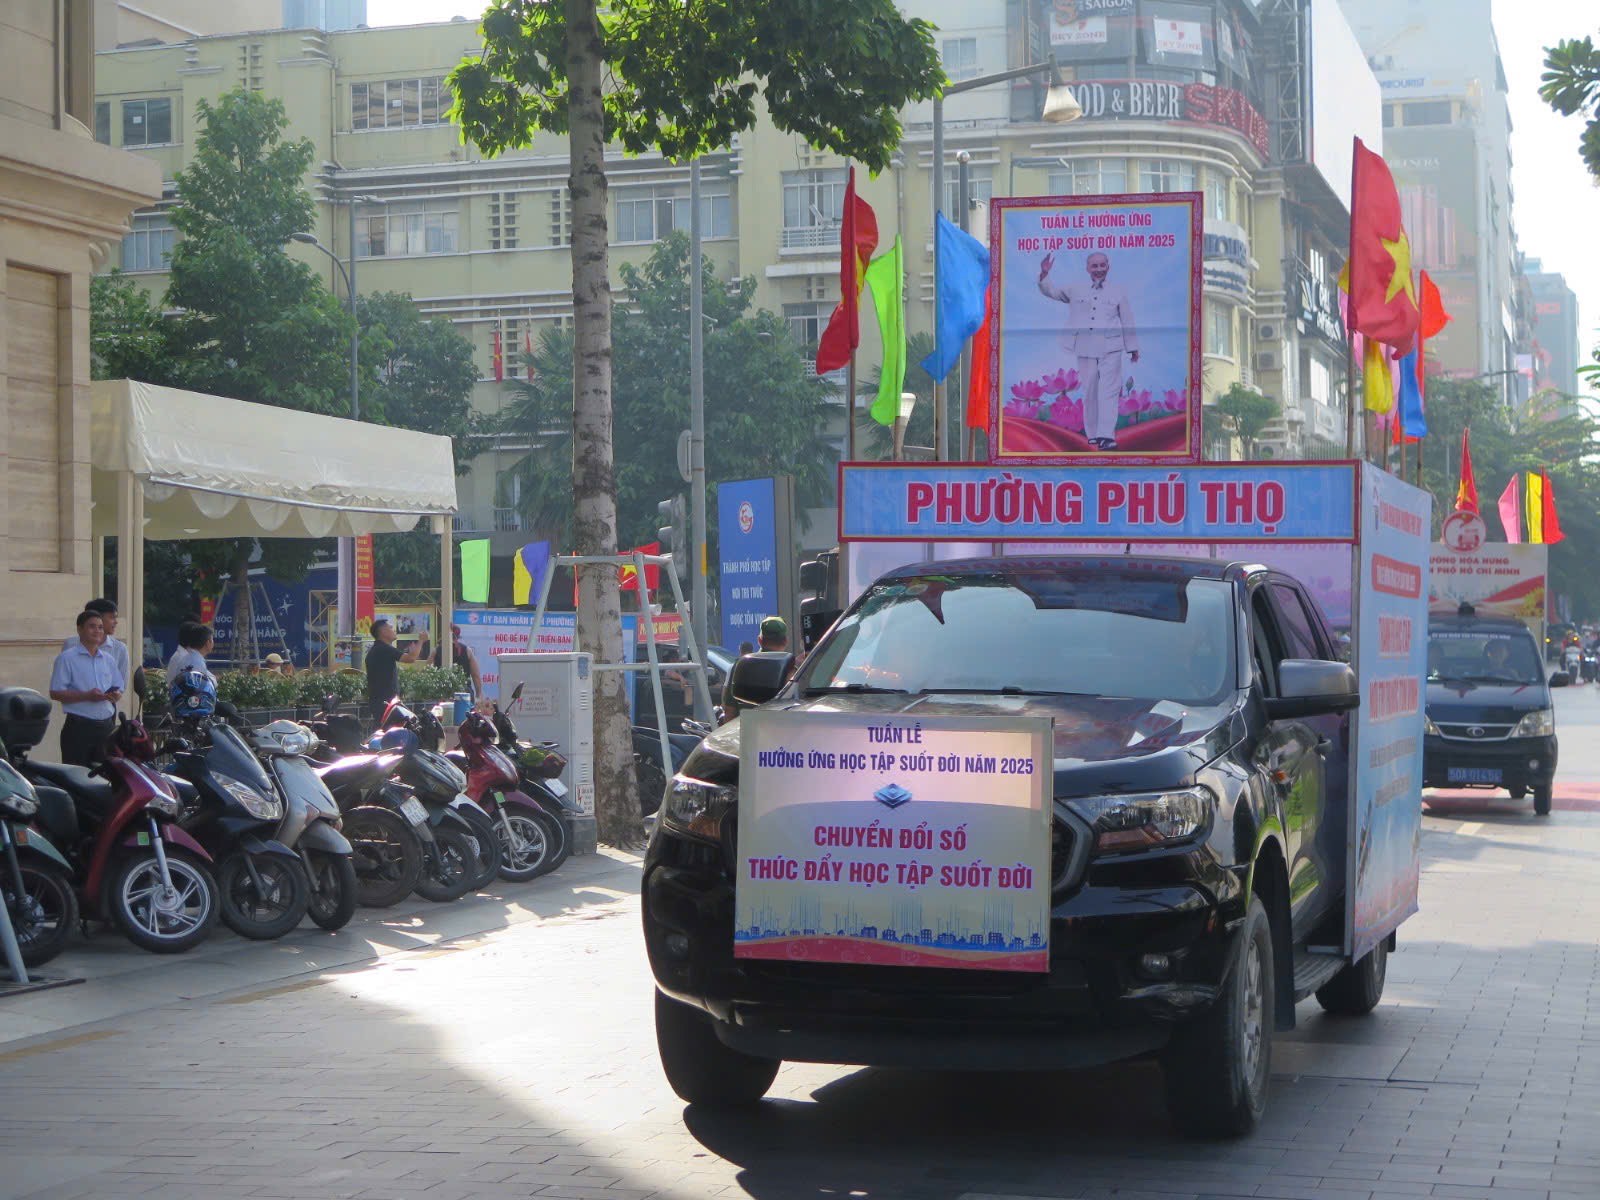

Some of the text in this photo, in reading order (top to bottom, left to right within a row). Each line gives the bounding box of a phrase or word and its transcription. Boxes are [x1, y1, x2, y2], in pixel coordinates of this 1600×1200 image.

[1111, 88, 1124, 113] &
[1128, 82, 1180, 118] BEER
[1088, 210, 1126, 228] HƯỞNG
[1129, 209, 1152, 227] ỨNG
[1018, 233, 1175, 254] HỌC TẬP SUỐT ĐỜI NĂM 2025
[907, 471, 1286, 533] PHƯỜNG PHÚ THỌ
[867, 721, 922, 744] TUẦN LỄ
[758, 746, 1034, 775] HƯỞNG ỨNG HỌC TẬP SUỐT ĐỜI NĂM 2025
[814, 818, 968, 851] CHUYỂN ĐỔI SỐ
[748, 852, 1033, 889] THÚC ĐẨY HỌC TẬP SUỐT ĐỜI
